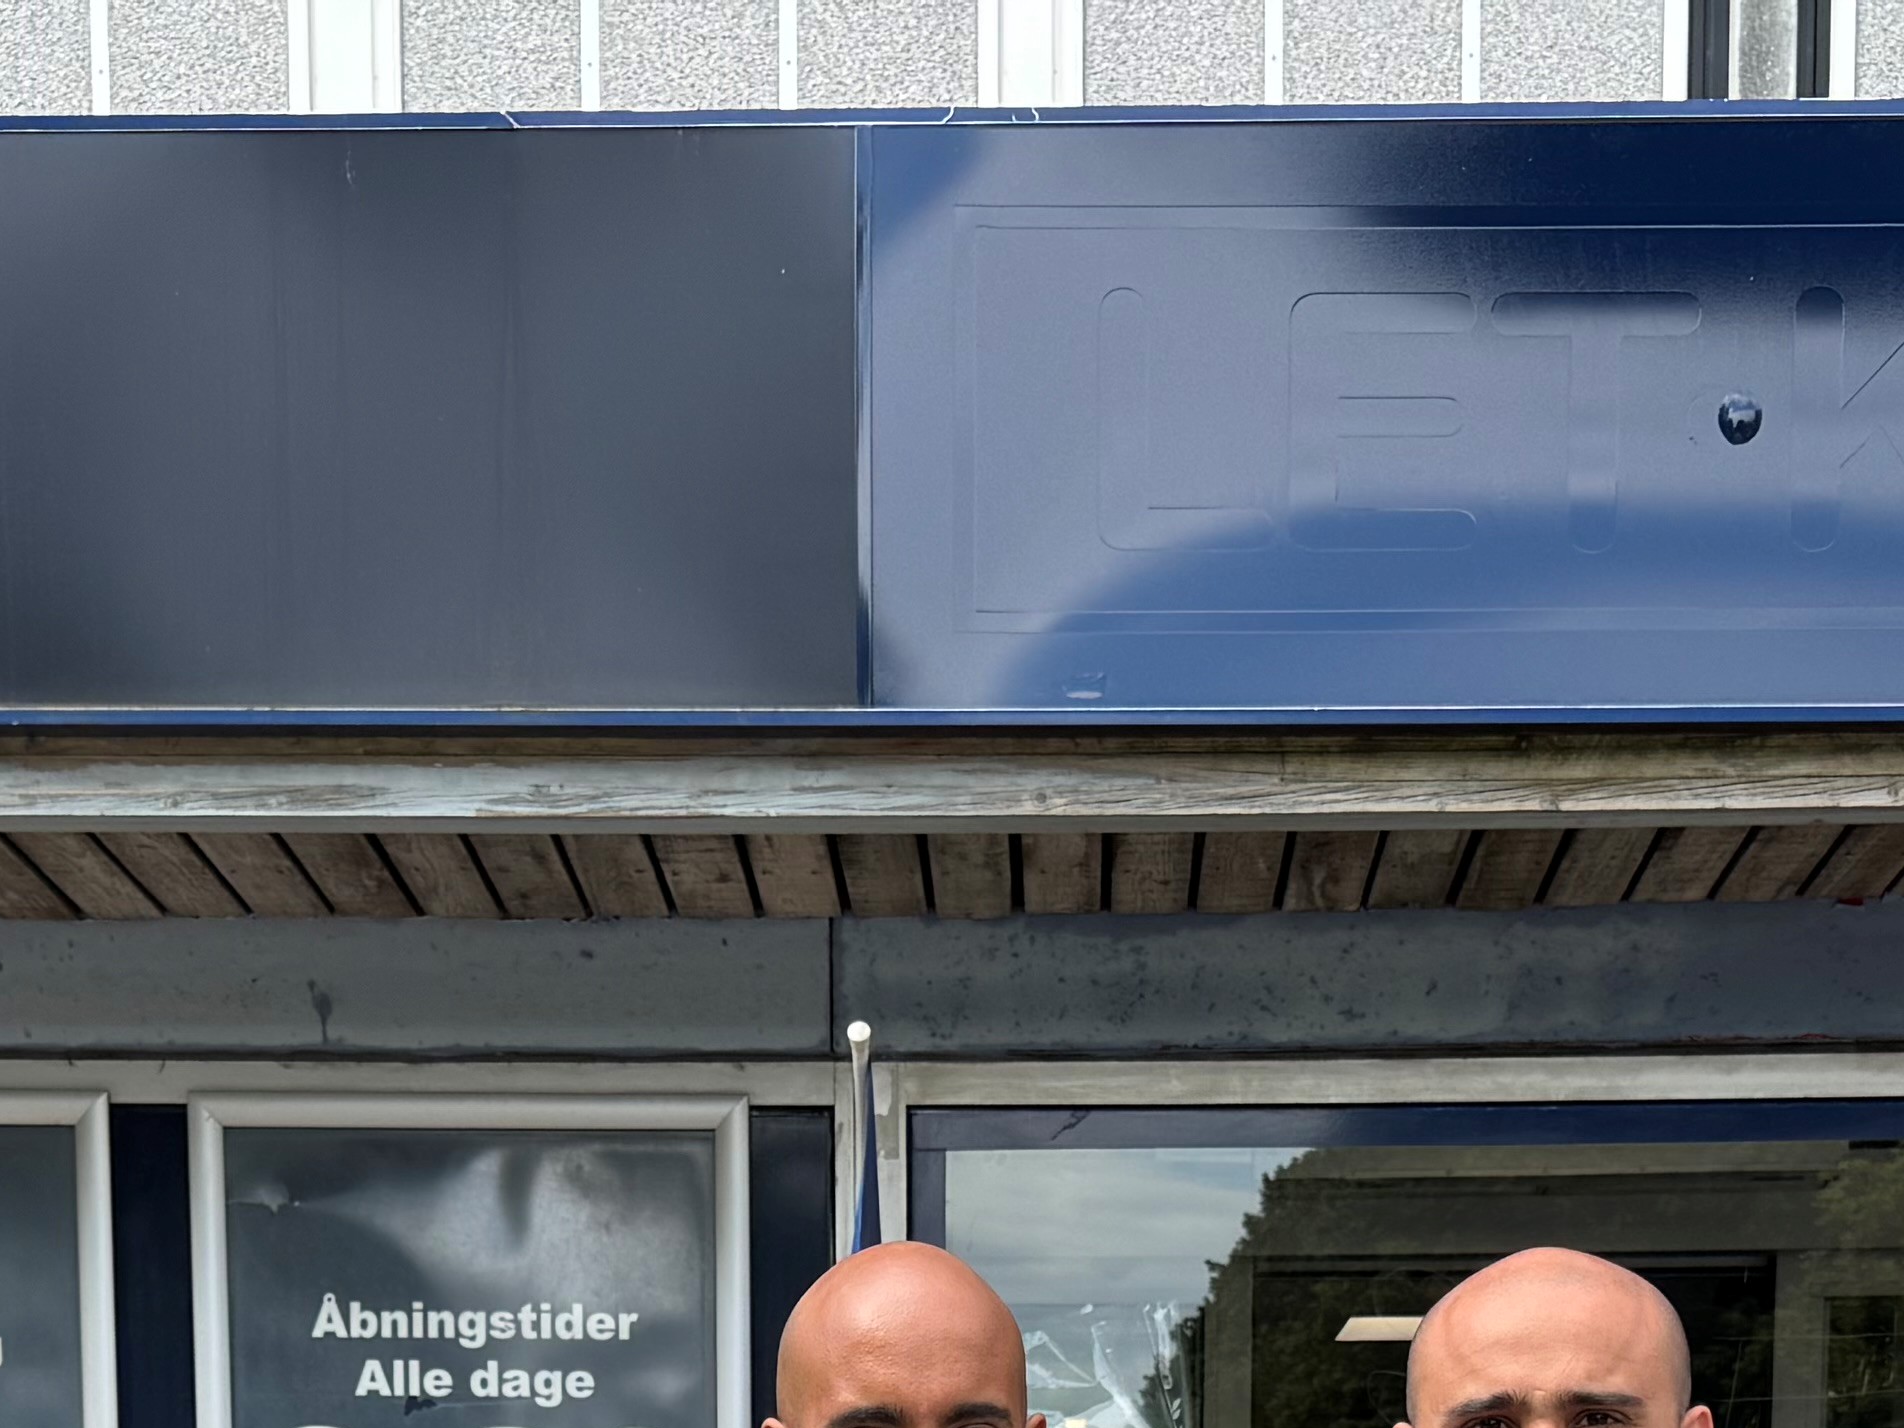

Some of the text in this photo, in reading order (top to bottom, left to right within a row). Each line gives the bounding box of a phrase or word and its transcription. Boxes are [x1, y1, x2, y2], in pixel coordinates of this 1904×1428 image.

[312, 1293, 639, 1348] Åbningstider
[355, 1360, 595, 1407] Alle dage
